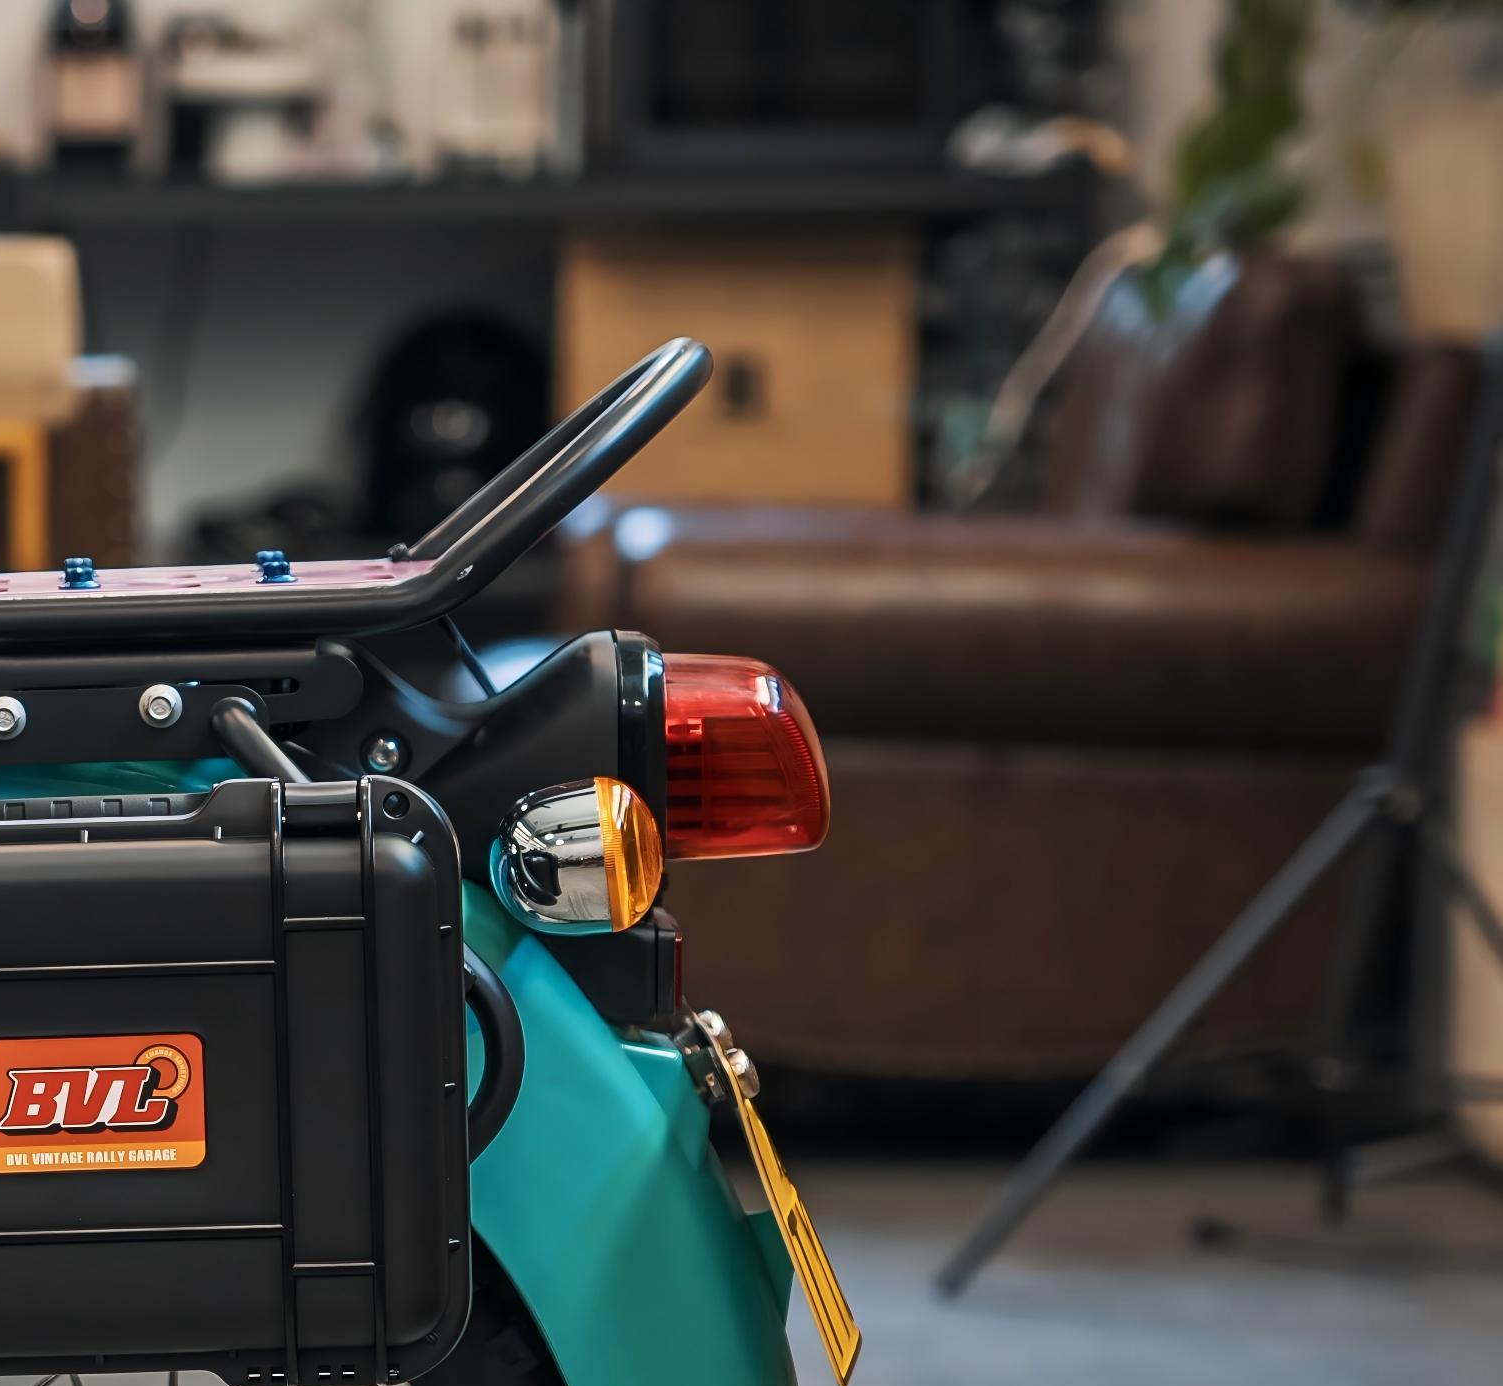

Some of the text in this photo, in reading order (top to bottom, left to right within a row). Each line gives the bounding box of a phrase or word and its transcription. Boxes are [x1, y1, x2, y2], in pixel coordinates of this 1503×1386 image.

[6, 1148, 178, 1166] BVL VINTAGE RALLY GARAGE
